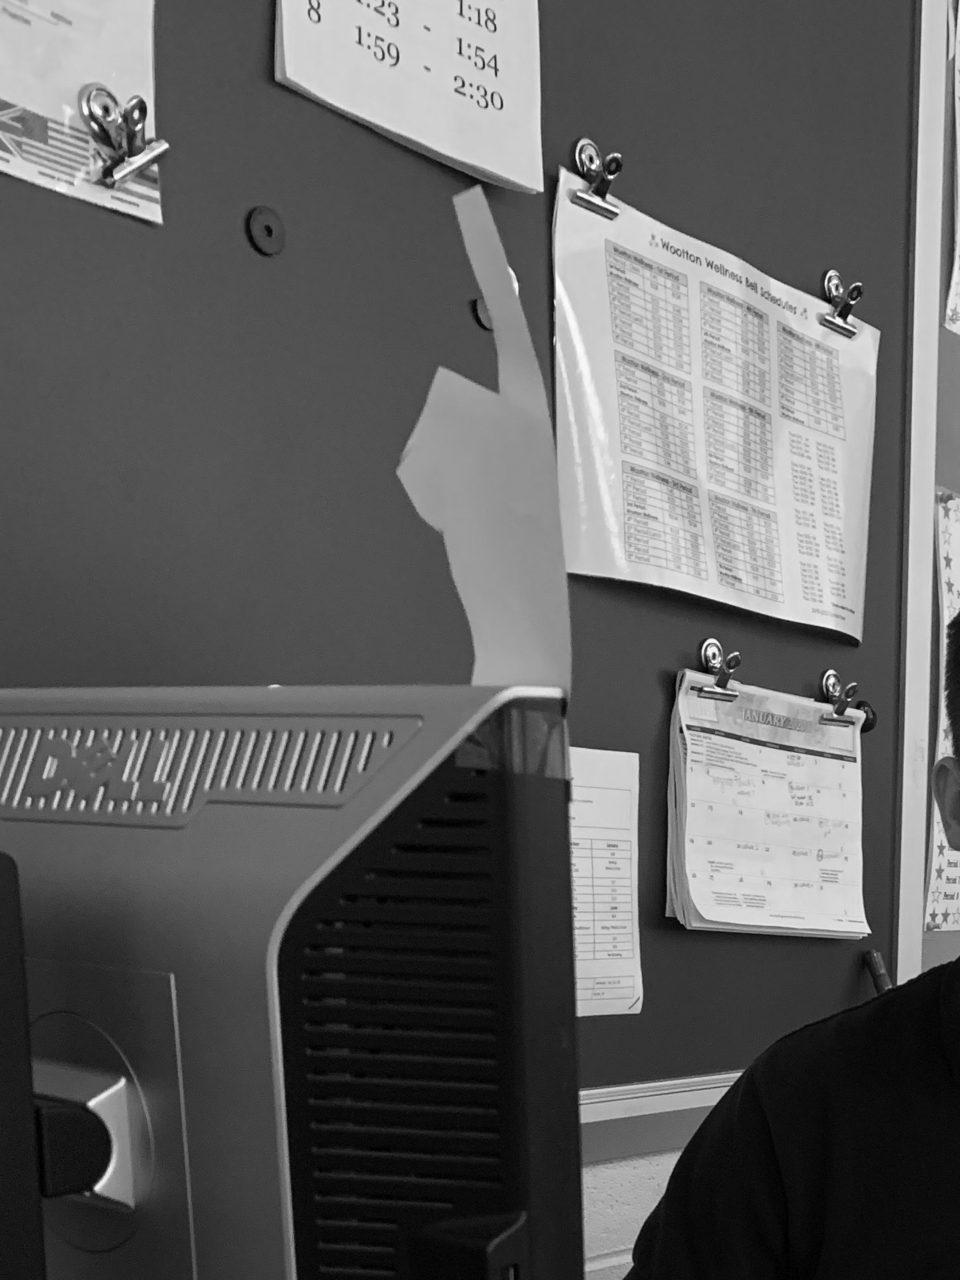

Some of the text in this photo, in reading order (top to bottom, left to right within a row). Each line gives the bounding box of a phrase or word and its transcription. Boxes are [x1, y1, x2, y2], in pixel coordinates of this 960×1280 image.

[308, 0, 321, 24] 8
[355, 26, 400, 67] 1:59
[453, 75, 504, 111] 2:30
[456, 37, 500, 78] 1:54
[661, 238, 702, 267] Wootton
[705, 257, 743, 285] Wellness
